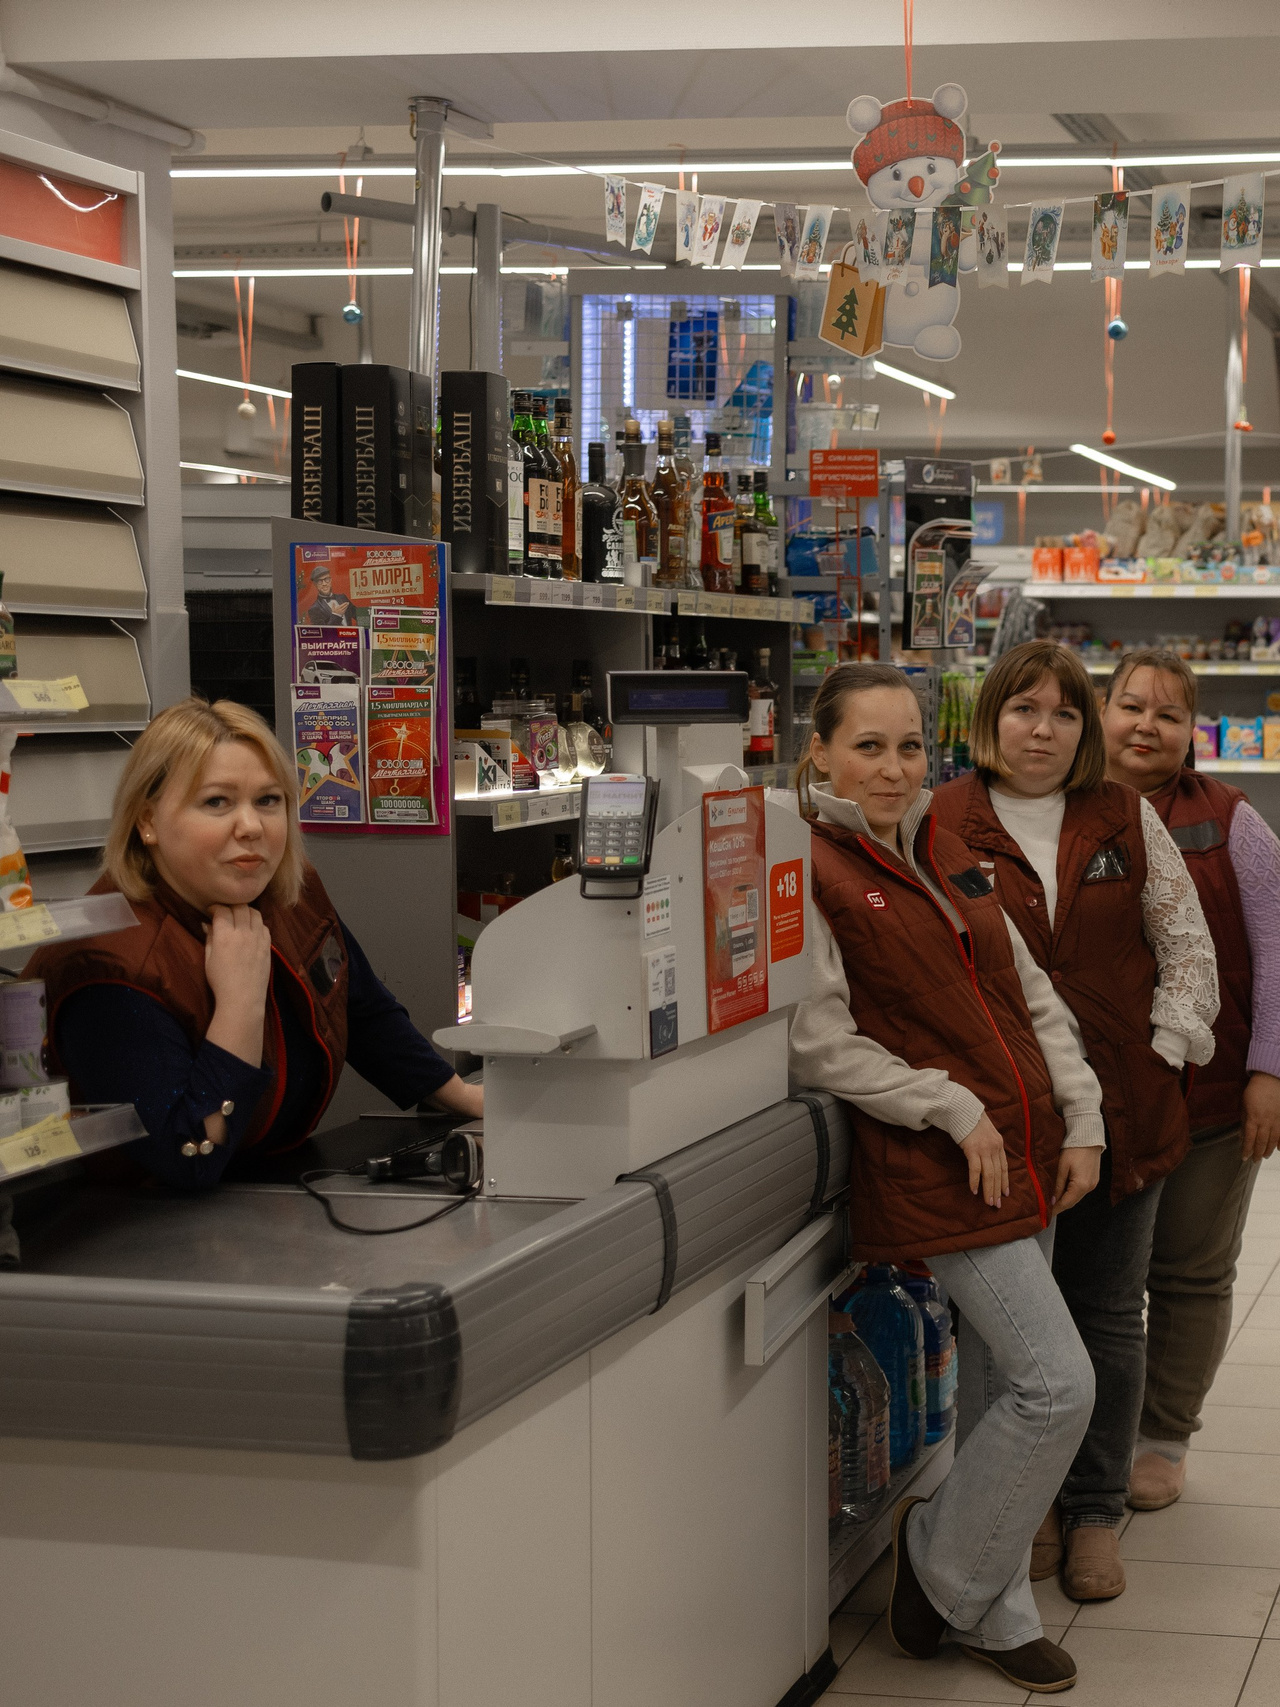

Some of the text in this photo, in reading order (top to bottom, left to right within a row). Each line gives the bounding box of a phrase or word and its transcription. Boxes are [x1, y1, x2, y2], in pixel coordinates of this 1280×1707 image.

[302, 406, 323, 523] ИЗБЕРБАШ
[356, 406, 376, 529] ИЗБЕРБАШ
[452, 411, 472, 533] ИЗБЕРБАШ
[352, 570, 368, 590] 1,5
[372, 567, 413, 587] МЛРД
[356, 589, 392, 597] РАЗЫГРАЕМ
[301, 640, 358, 650] ВЫИГРАЙТЕ
[376, 634, 388, 644] 1,5
[371, 702, 381, 710] 1,5
[733, 836, 746, 849] 10%
[777, 871, 797, 898] +18
